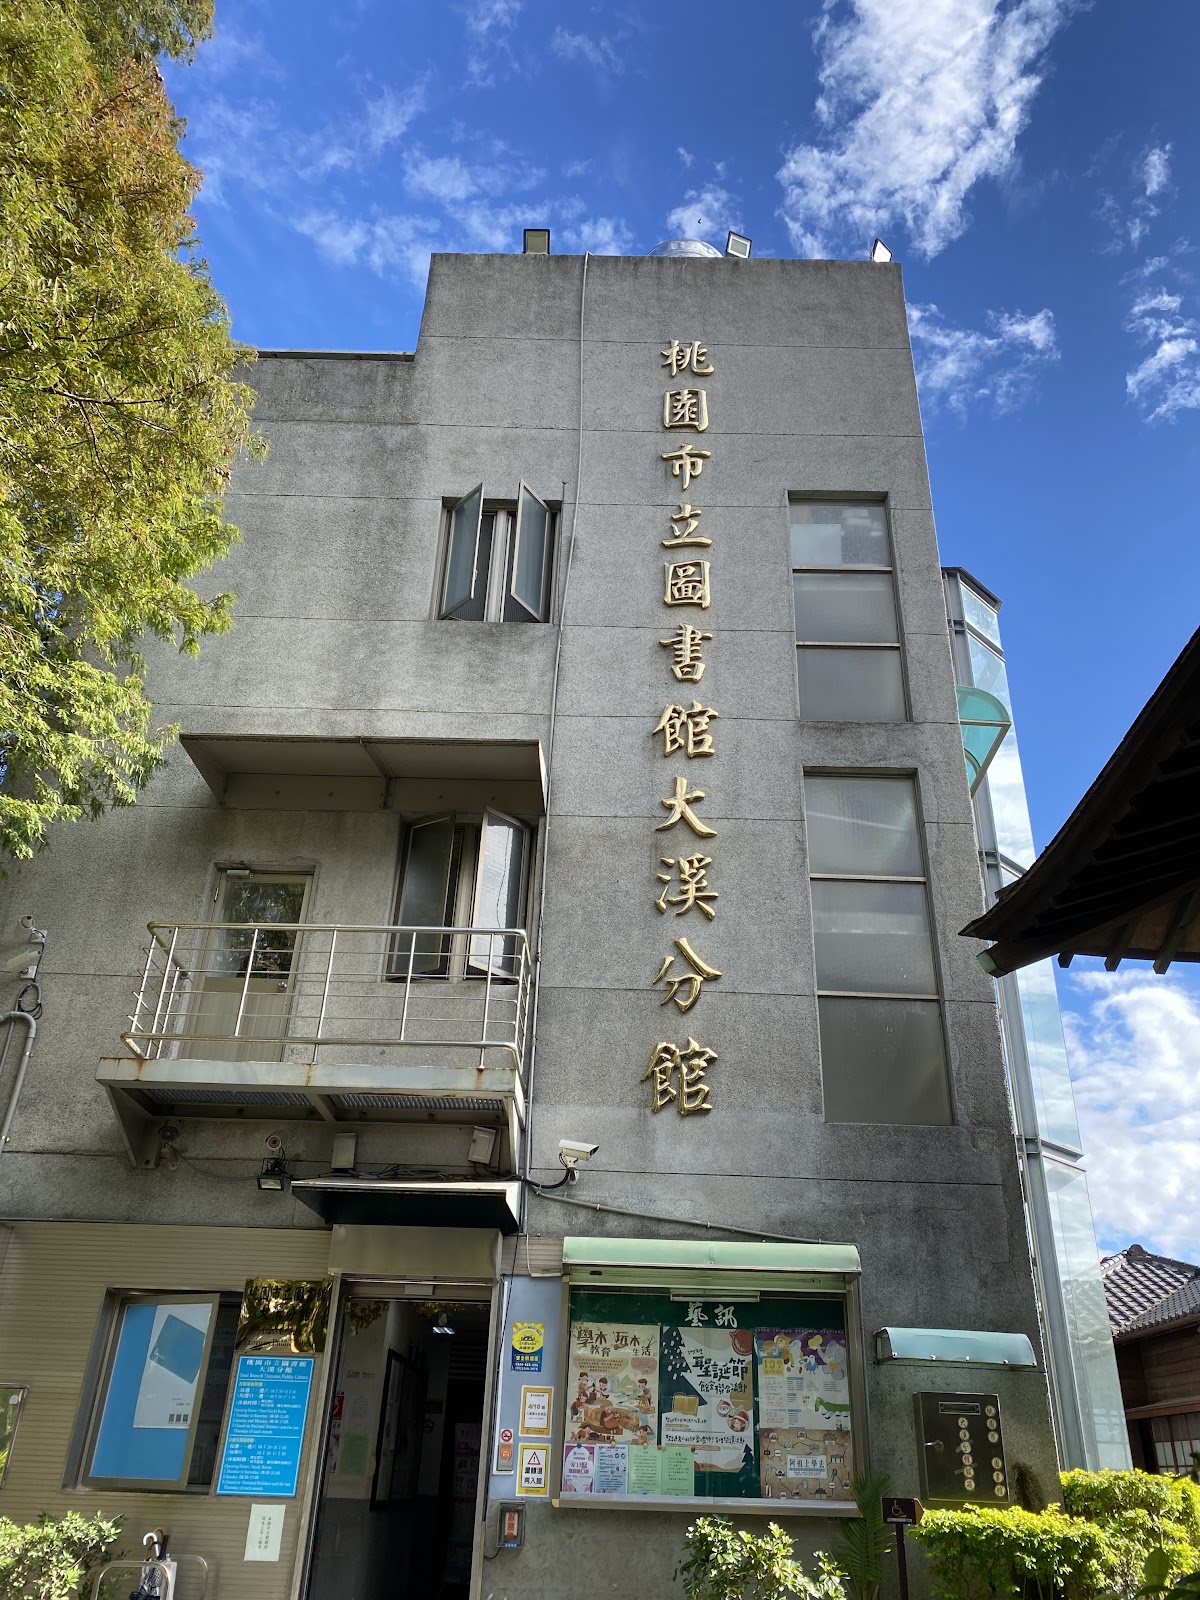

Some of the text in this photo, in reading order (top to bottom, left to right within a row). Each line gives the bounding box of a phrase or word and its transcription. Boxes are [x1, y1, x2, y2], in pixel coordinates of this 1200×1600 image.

[640, 338, 722, 1117] 桃園市立圖書館大溪分館
[684, 1302, 737, 1328] 藝訊
[692, 1356, 748, 1382] 聖誕節
